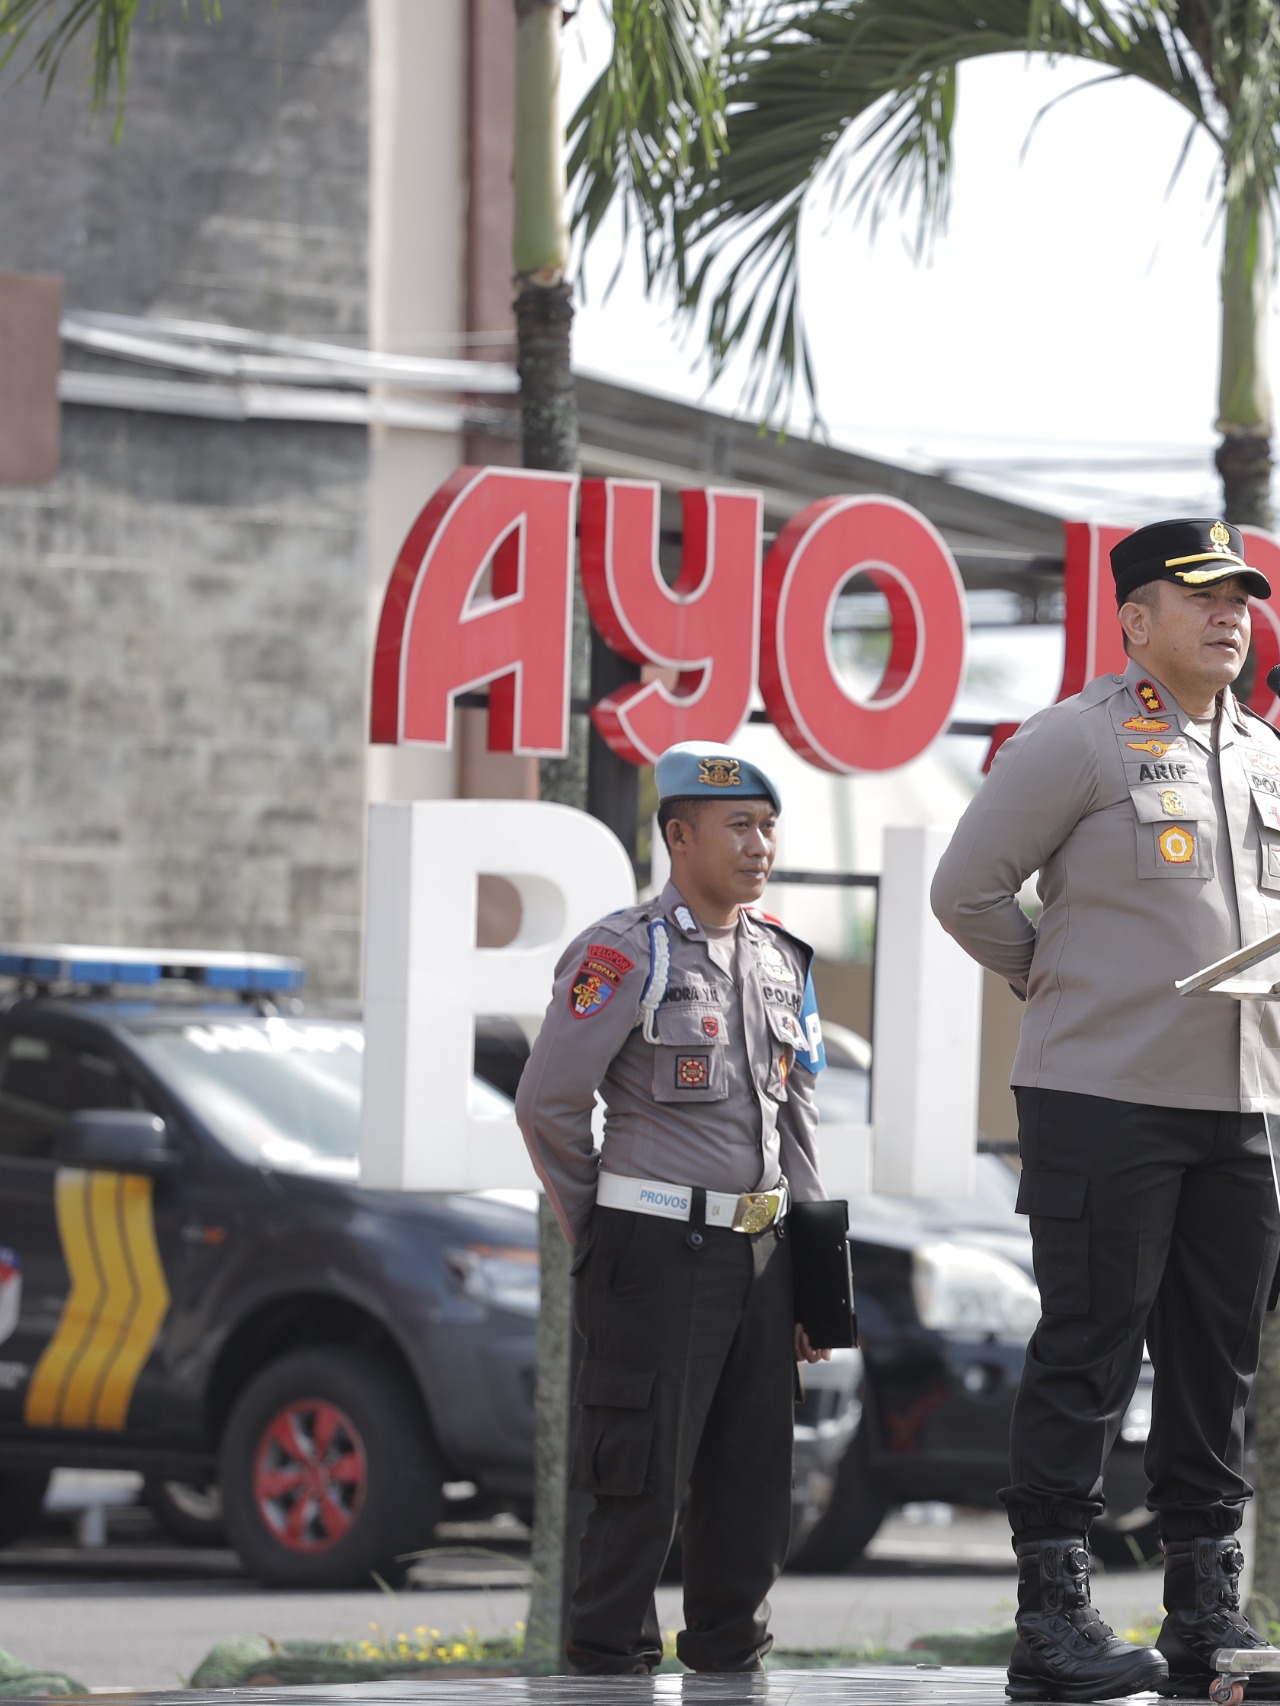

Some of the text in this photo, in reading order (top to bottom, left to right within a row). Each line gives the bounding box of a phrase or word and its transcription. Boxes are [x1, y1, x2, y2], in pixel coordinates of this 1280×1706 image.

[371, 465, 969, 776] AYO
[1139, 763, 1189, 782] ARIF
[591, 946, 630, 970] PELOPOR
[588, 961, 617, 978] PROPAM
[663, 985, 699, 1002] NDRA
[639, 1188, 689, 1210] PROVOS
